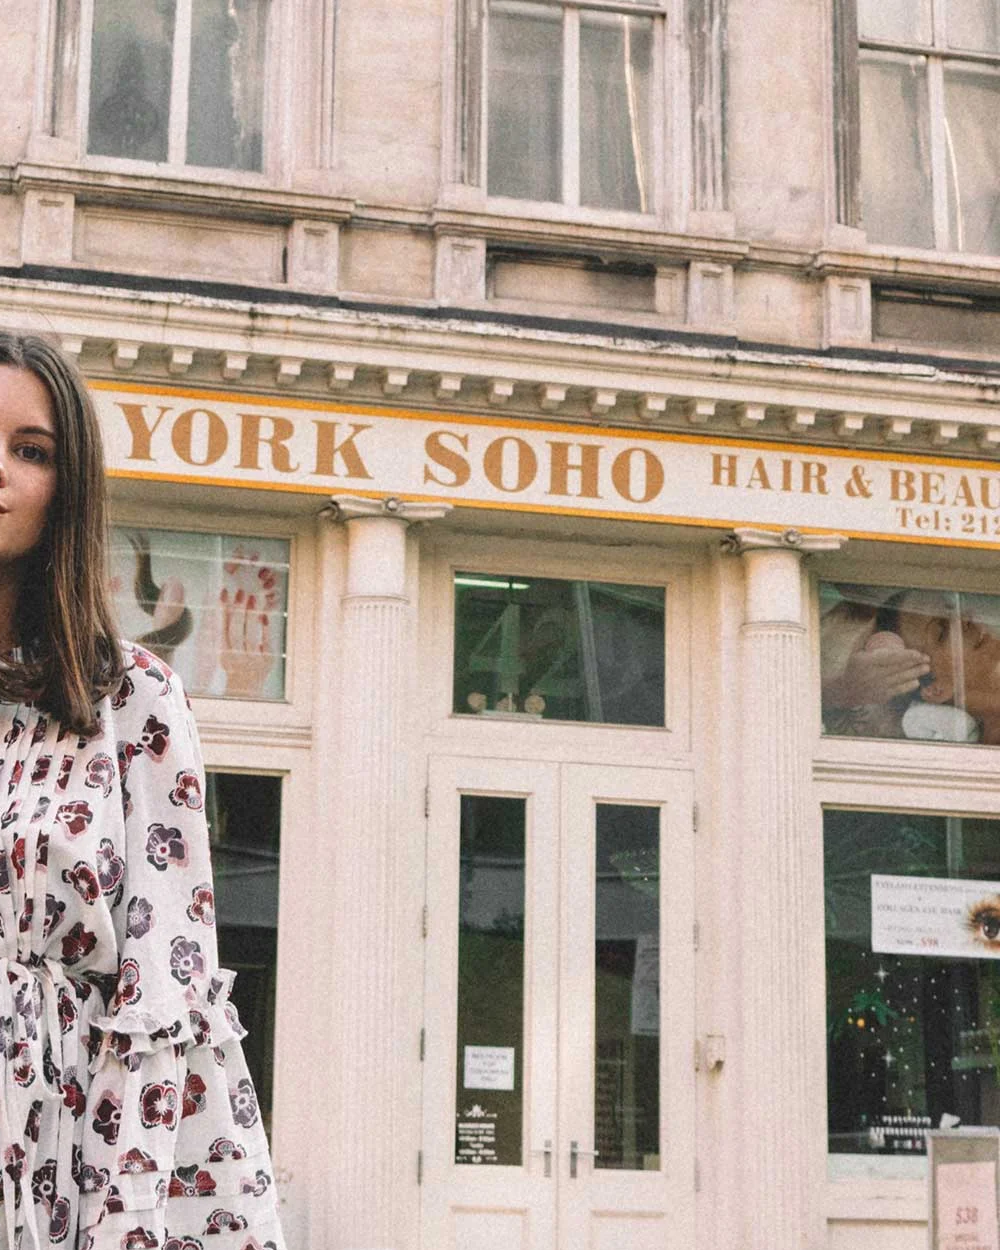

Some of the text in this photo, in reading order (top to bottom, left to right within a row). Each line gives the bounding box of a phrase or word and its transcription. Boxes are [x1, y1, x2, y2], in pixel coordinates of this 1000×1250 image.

[113, 402, 1000, 510] YORK SOHO HAIR & BEAU
[896, 507, 951, 531] Tel:
